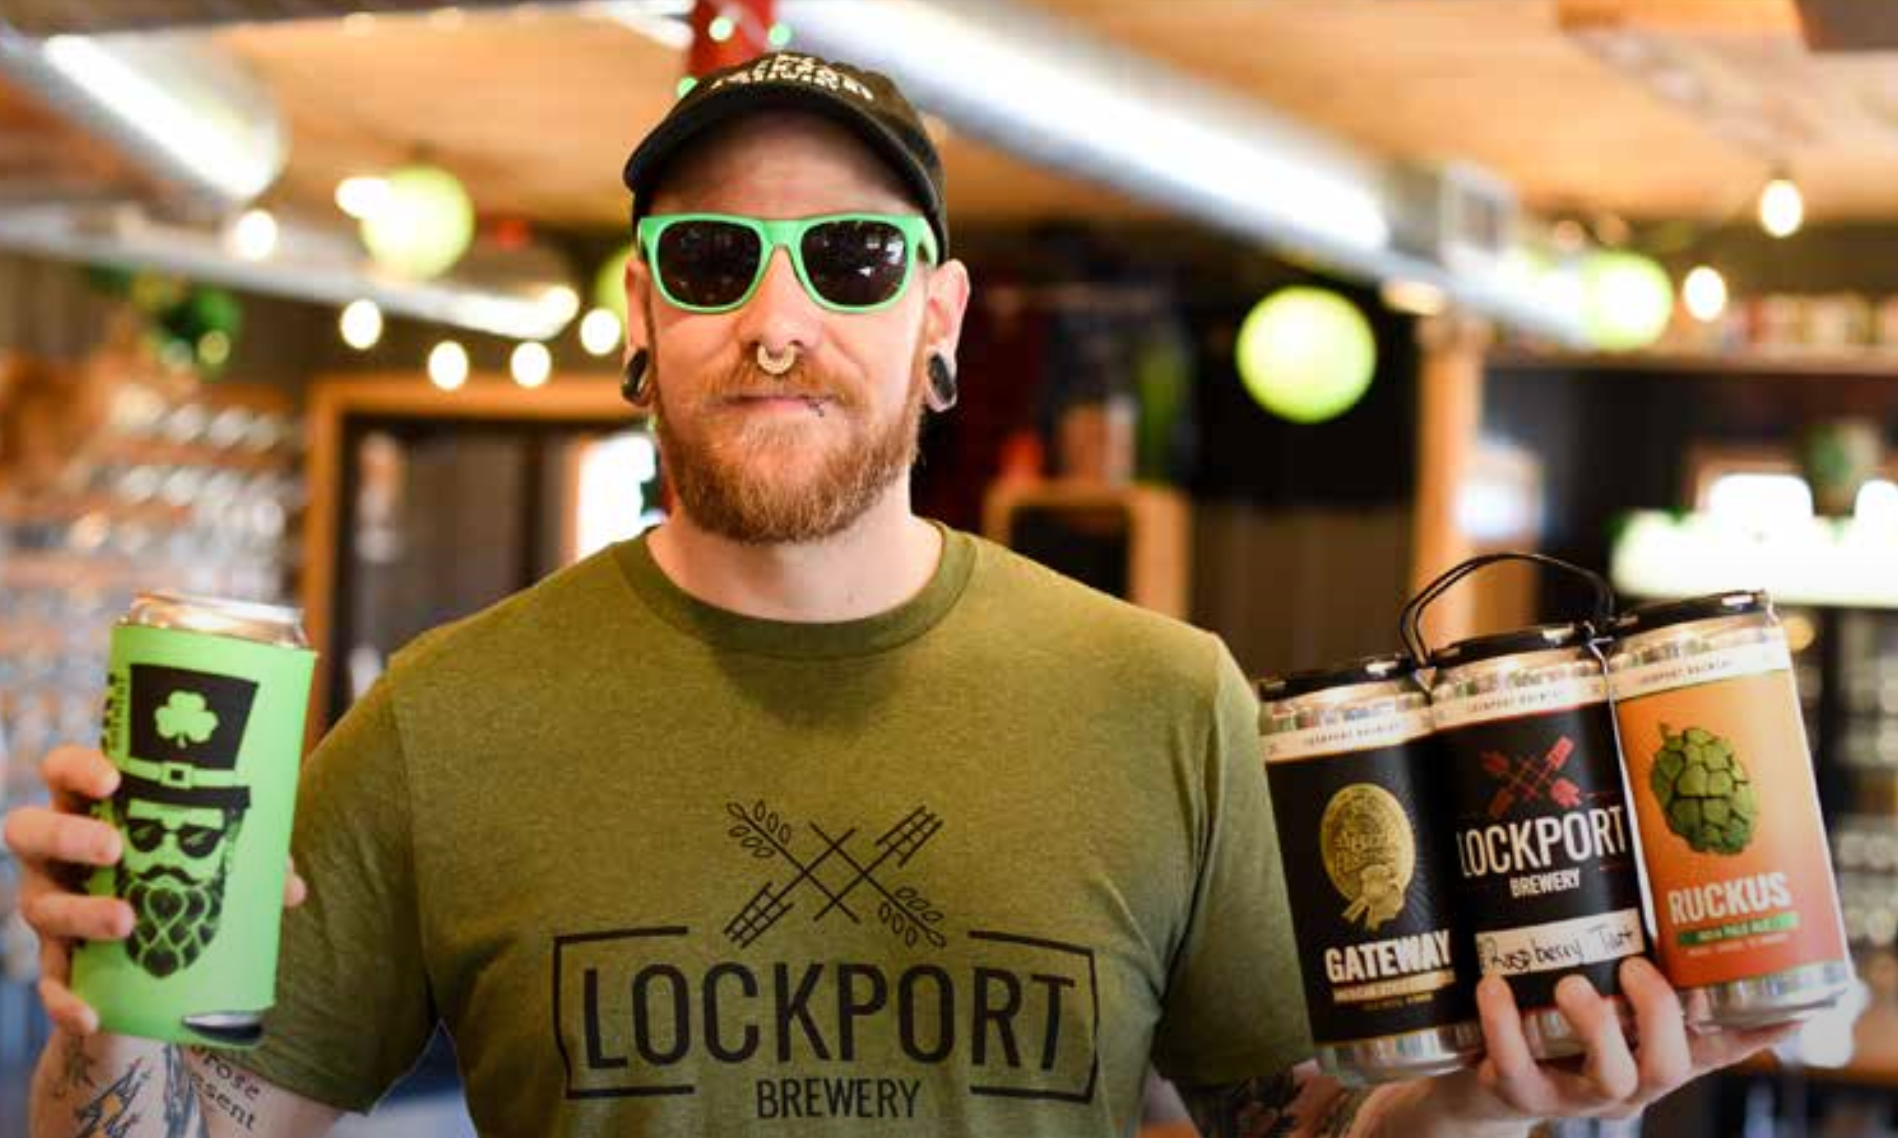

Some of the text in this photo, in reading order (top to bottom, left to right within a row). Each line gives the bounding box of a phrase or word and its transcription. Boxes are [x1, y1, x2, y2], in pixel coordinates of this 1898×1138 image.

[1456, 806, 1626, 878] LOCKPORT
[1509, 867, 1581, 898] BREWERY
[1667, 871, 1792, 925] RUCKUS
[1325, 928, 1450, 983] GATEWAY
[583, 960, 1076, 1071] LOCKPORT
[756, 1077, 922, 1120] BREWERY
